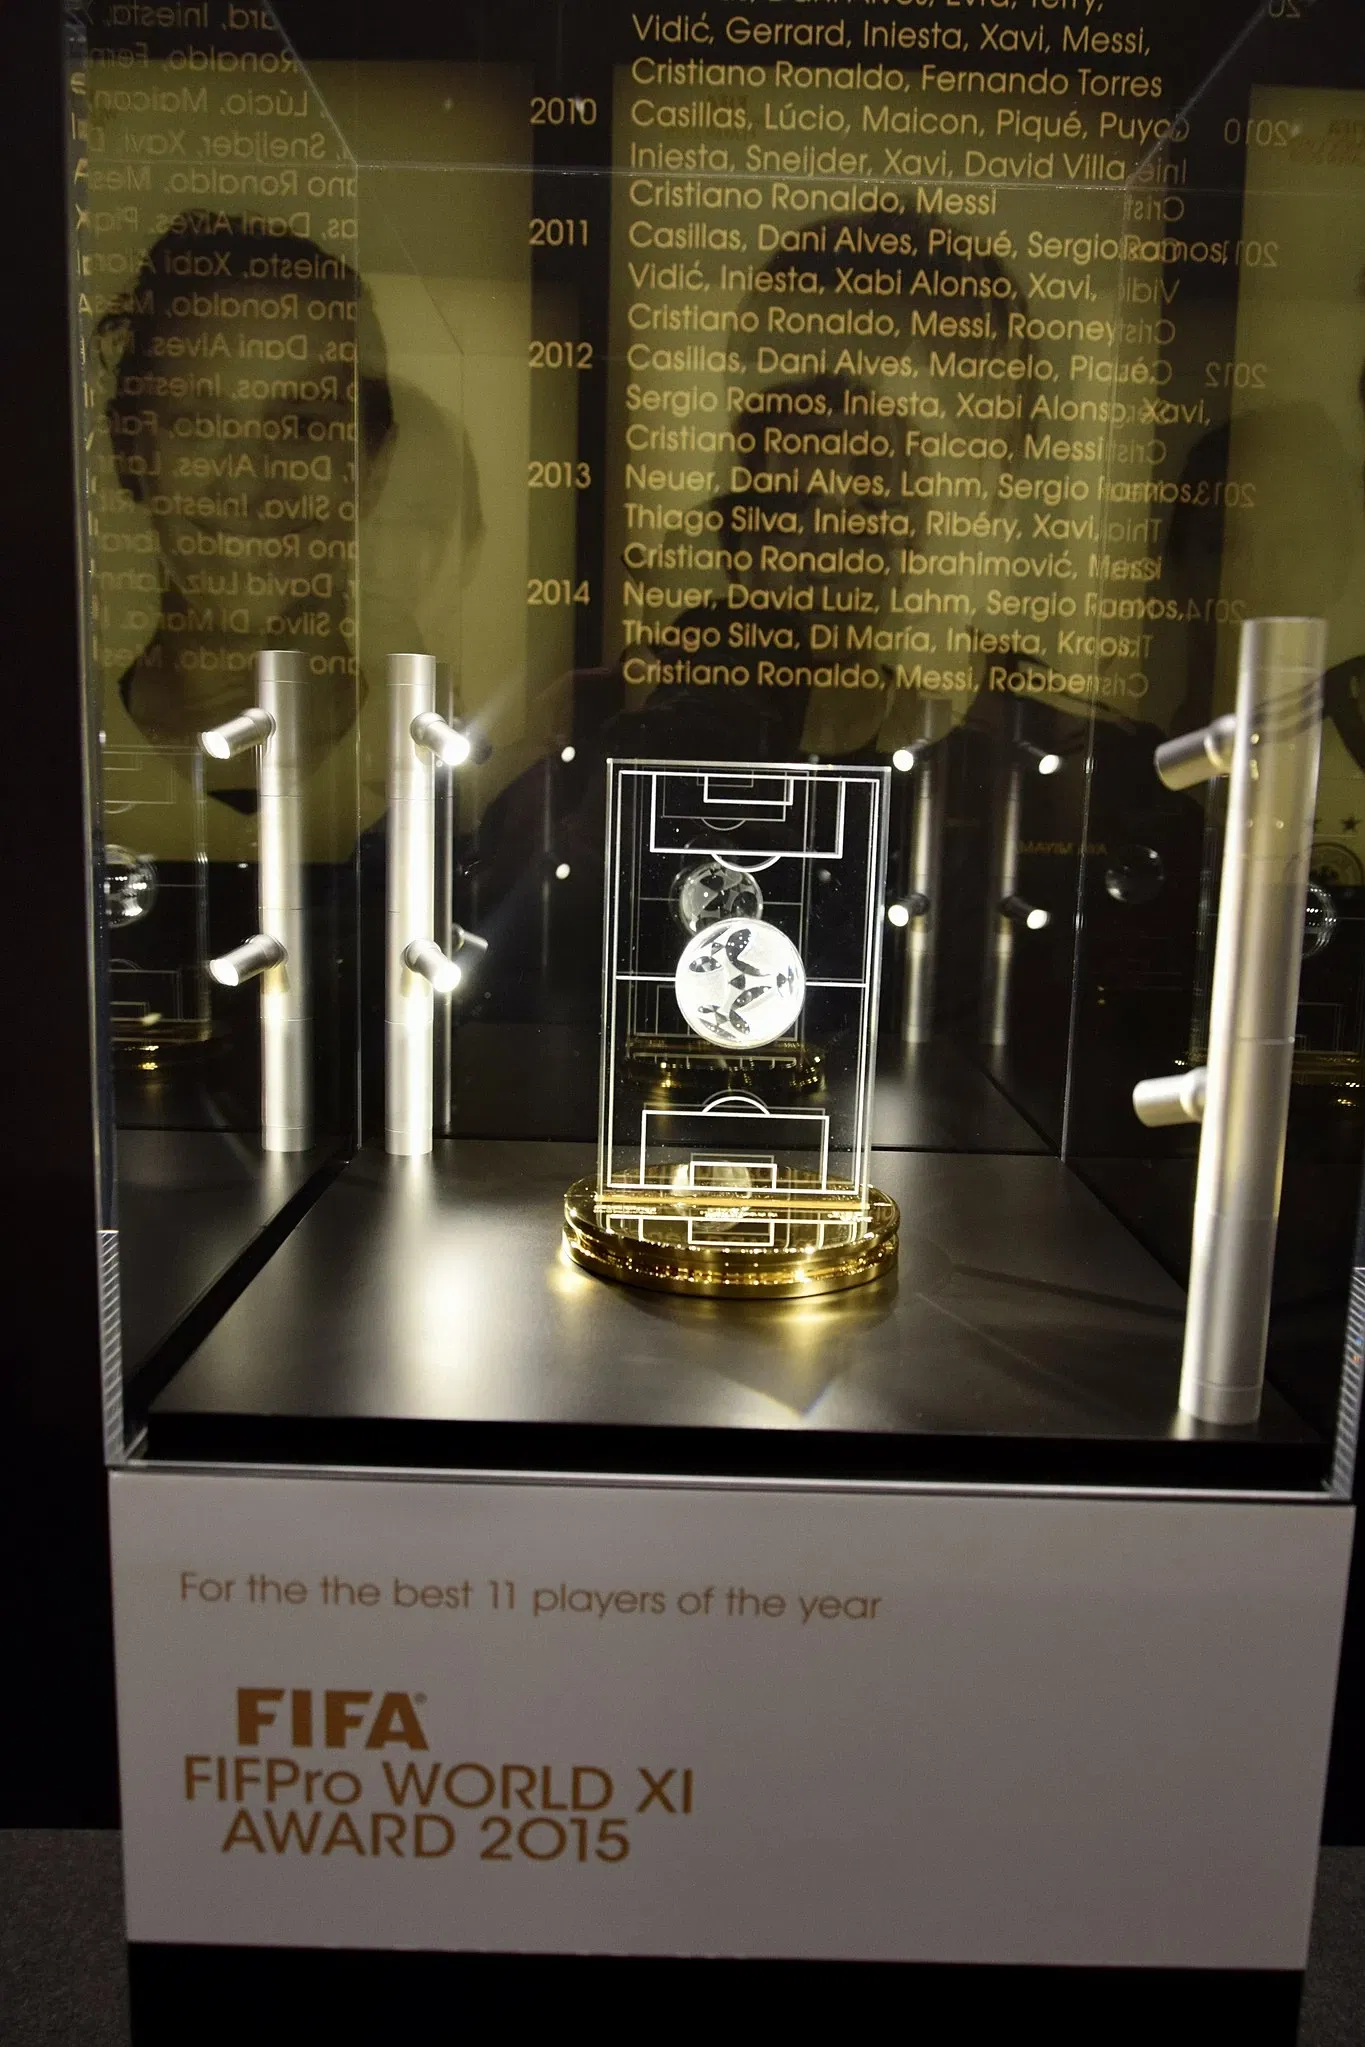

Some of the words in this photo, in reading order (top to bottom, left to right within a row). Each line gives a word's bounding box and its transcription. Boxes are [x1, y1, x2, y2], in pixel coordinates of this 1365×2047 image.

[633, 12, 714, 46] Vidić,
[726, 16, 852, 48] Gerrard,
[864, 20, 968, 52] Iniesta,
[980, 23, 1050, 54] Xavi,
[1063, 25, 1150, 56] Messi,
[632, 57, 766, 87] Cristiano
[775, 60, 910, 92] Ronaldo,
[922, 63, 1069, 96] Fernando
[1077, 67, 1162, 97] Torres
[530, 97, 597, 125] 2010
[631, 100, 753, 130] Casillas,
[765, 103, 851, 134] Lúcio,
[863, 105, 985, 137] Maicon,
[997, 109, 1088, 142] Piqué,
[629, 142, 735, 172] Iniesta,
[746, 145, 873, 178] Sneijder,
[883, 148, 953, 178] Xavi,
[965, 151, 1053, 180] David
[1063, 153, 1125, 181] Villa
[629, 179, 763, 210] Cristiano
[771, 183, 905, 214] Ronaldo,
[916, 186, 997, 216] Messi
[528, 218, 588, 246] 2011
[628, 220, 748, 251] Casillas,
[757, 224, 827, 252] Dani
[834, 226, 919, 256] Alves,
[928, 229, 1018, 262] Piqué,
[1028, 231, 1118, 266] Sergio
[628, 260, 710, 292] Vidić,
[720, 264, 825, 296] Iniesta,
[834, 267, 902, 296] Xabi
[910, 269, 1018, 300] Alonso,
[1028, 272, 1097, 302] Xavi,
[627, 303, 760, 333] Cristiano
[768, 306, 900, 338] Ronaldo,
[911, 310, 997, 341] Messi,
[1008, 313, 1114, 346] Rooney
[528, 341, 593, 370] 2012
[627, 344, 746, 375] Casillas,
[756, 347, 826, 376] Dani
[833, 349, 919, 380] Alves,
[929, 351, 1060, 383] Marcelo,
[625, 385, 718, 418] Sergio
[726, 386, 833, 418] Ramos,
[843, 389, 946, 421] Iniesta,
[956, 392, 1023, 421] Xabi
[1140, 397, 1211, 427] Xavi,
[625, 423, 757, 454] Cristiano
[764, 426, 895, 459] Ronaldo,
[905, 430, 1014, 461] Falcao,
[1024, 433, 1103, 462] Messi
[527, 461, 592, 491] 2013
[624, 463, 721, 495] Neuer,
[730, 465, 799, 495] Dani
[806, 468, 891, 500] Alves,
[900, 470, 988, 501] Lahm,
[998, 473, 1089, 506] Sergio
[623, 502, 724, 537] Thiago
[730, 504, 804, 535] Silva,
[813, 507, 916, 538] Iniesta,
[926, 510, 1022, 544] Ribéry,
[1031, 513, 1099, 543] Xavi,
[622, 541, 753, 572] Cristiano
[760, 545, 891, 576] Ronaldo,
[900, 548, 1078, 581] Ibrahimović,
[1088, 554, 1163, 581] Messi
[526, 579, 591, 607] 2014
[622, 580, 718, 612] Neuer,
[727, 583, 814, 612] David
[821, 586, 881, 616] Luiz,
[890, 587, 977, 618] Lahm,
[986, 589, 1077, 623] Sergio
[621, 619, 722, 654] Thiago
[727, 621, 801, 652] Silva,
[810, 623, 839, 651] Di
[847, 621, 937, 656] María,
[946, 628, 1047, 658] Iniesta,
[621, 657, 751, 687] Cristiano
[756, 660, 887, 690] Ronaldo,
[895, 664, 980, 695] Messi,
[180, 1571, 235, 1602] For
[246, 1573, 308, 1605] the
[318, 1575, 382, 1607] the
[393, 1577, 473, 1609] best
[489, 1580, 516, 1610] 11
[532, 1581, 667, 1620] players
[677, 1586, 715, 1617] of
[725, 1587, 787, 1618] the
[799, 1593, 883, 1625] year
[236, 1687, 430, 1752] FIFA
[185, 1755, 363, 1806] FIFPro
[381, 1760, 614, 1813] WORLD
[636, 1767, 693, 1815] XI
[222, 1807, 456, 1859] AWARD
[480, 1815, 631, 1863] 2015
